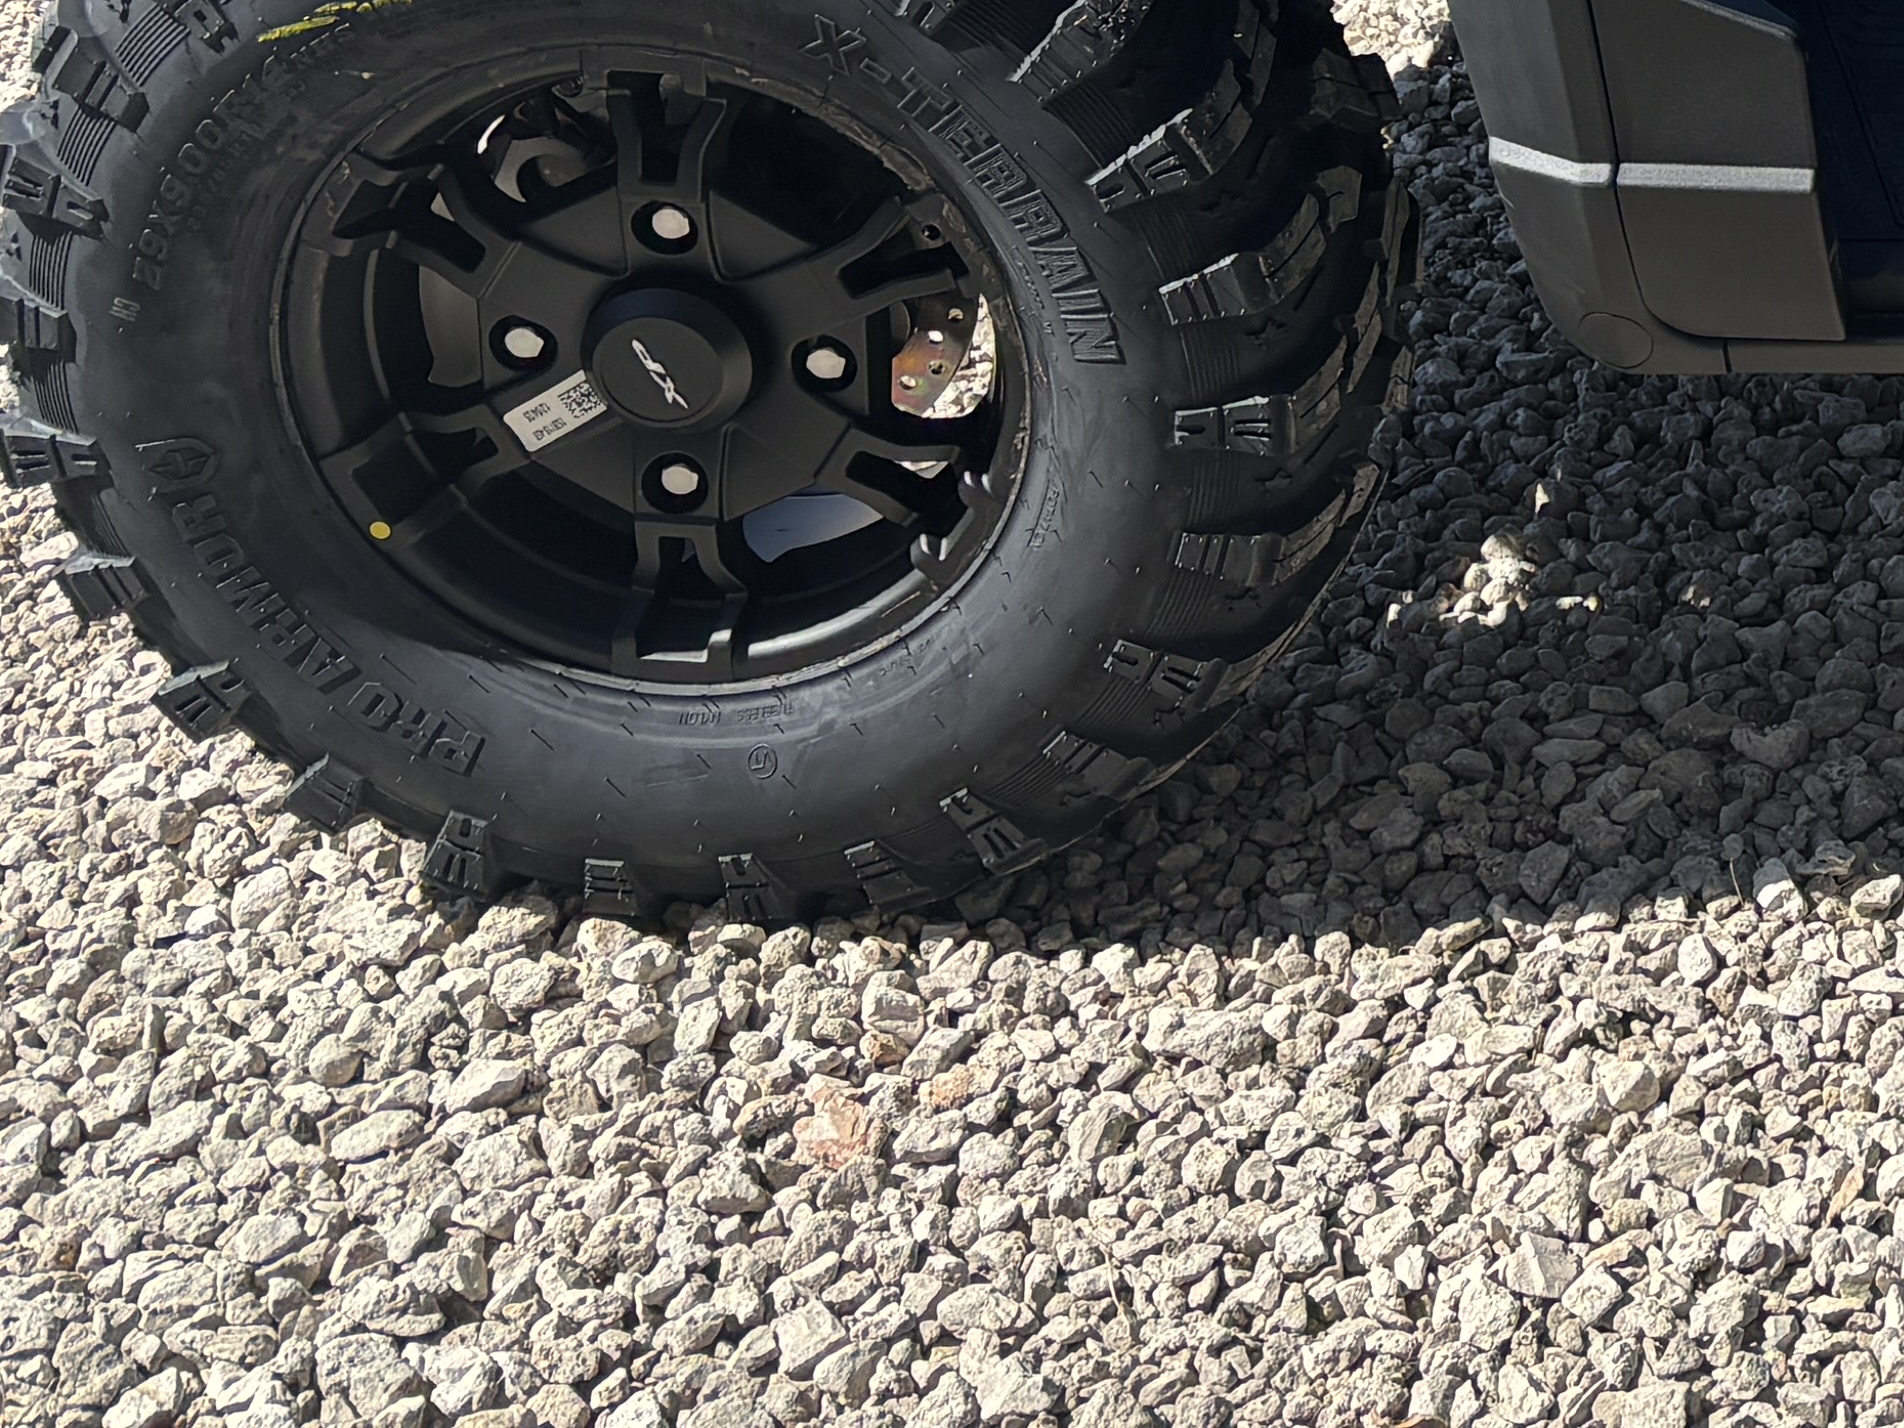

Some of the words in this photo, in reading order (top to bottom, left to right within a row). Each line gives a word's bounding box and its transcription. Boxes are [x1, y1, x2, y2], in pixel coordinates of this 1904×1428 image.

[800, 15, 1123, 364] X-TERRAIN
[170, 492, 361, 696] ARMOR
[347, 681, 487, 776] PRO
